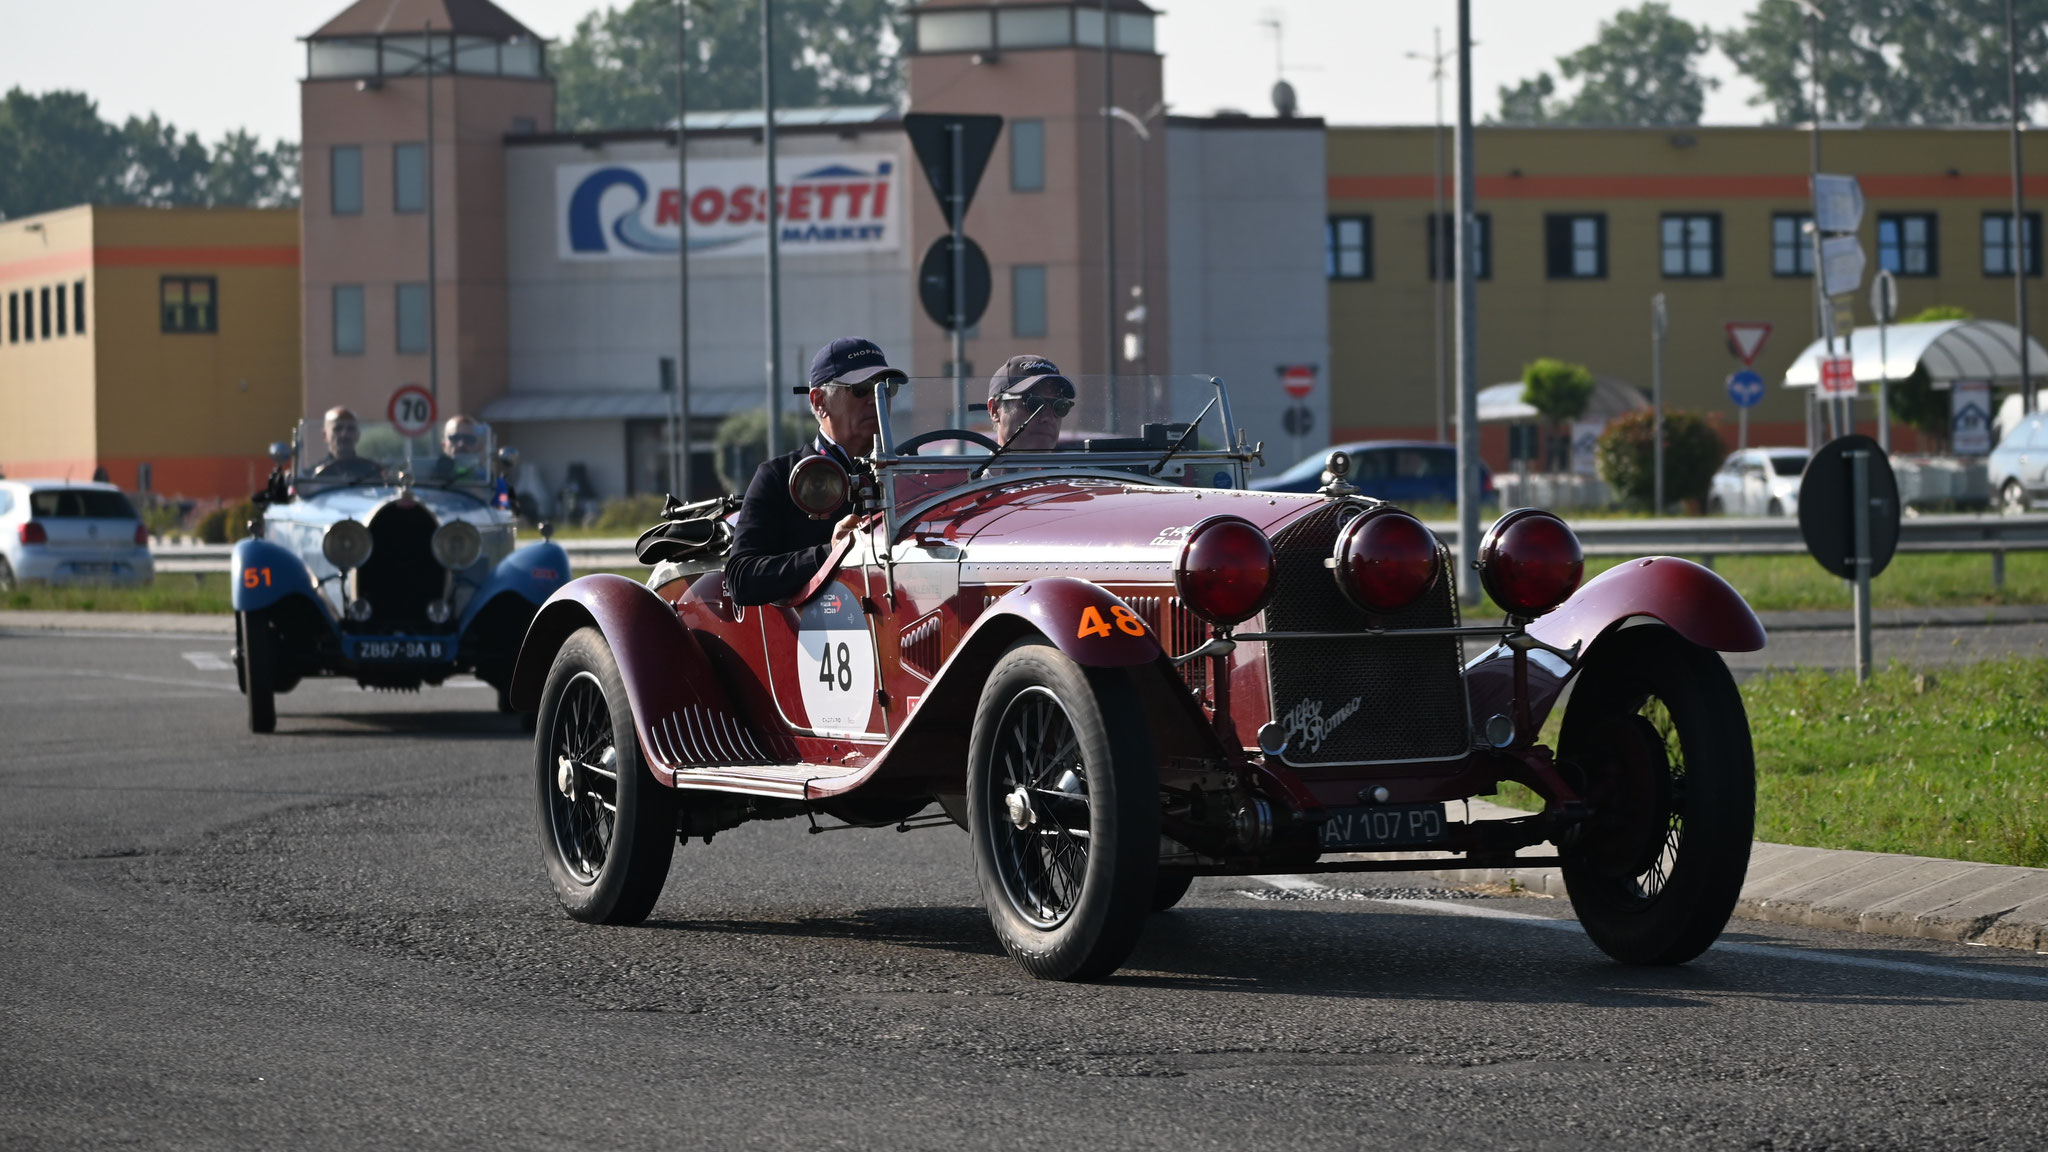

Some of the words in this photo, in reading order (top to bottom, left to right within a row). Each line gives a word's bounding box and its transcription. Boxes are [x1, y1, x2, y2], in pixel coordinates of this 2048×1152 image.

[655, 181, 890, 226] ROSSETTI
[782, 224, 885, 242] MARKET
[402, 398, 427, 422] 70
[244, 567, 272, 589] 51
[1077, 605, 1146, 639] 48
[819, 641, 852, 692] 48
[1282, 697, 1323, 741] Alfa
[1299, 696, 1363, 753] Romeo
[1360, 811, 1401, 839] 107
